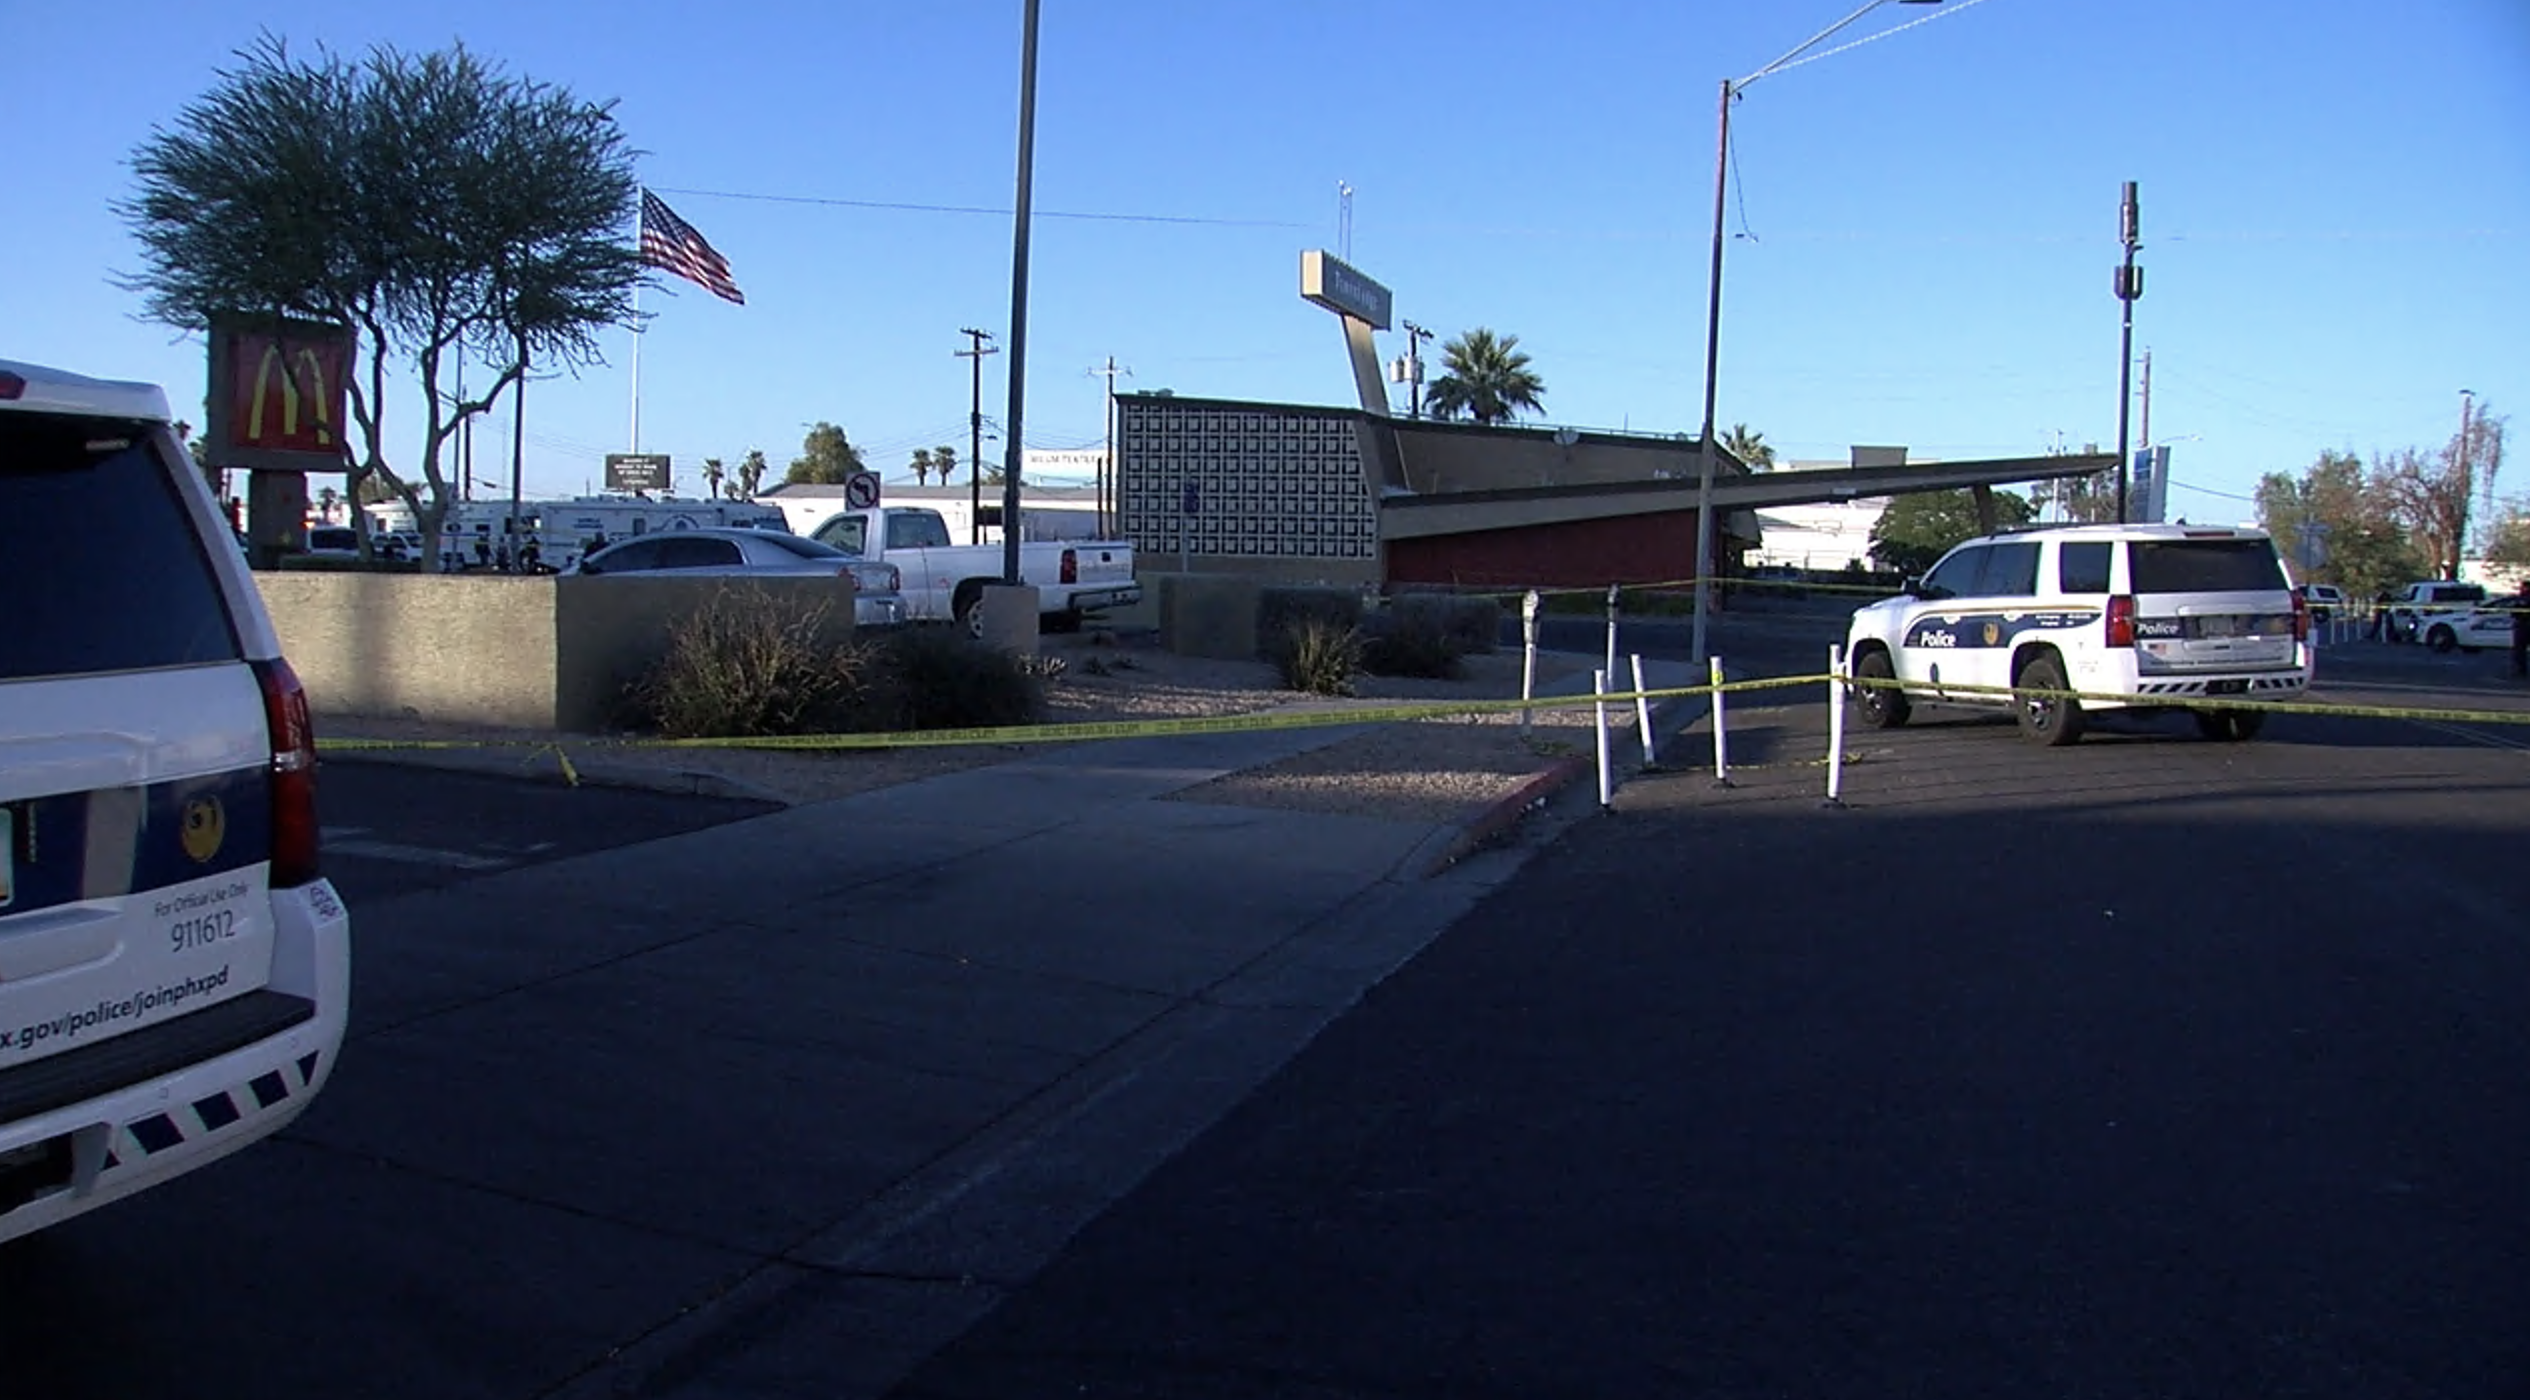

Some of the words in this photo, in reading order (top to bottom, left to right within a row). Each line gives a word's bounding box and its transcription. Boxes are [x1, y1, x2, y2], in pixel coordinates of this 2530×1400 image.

[2137, 622, 2179, 635] Police
[1921, 630, 1957, 647] Police
[171, 909, 236, 953] 911612
